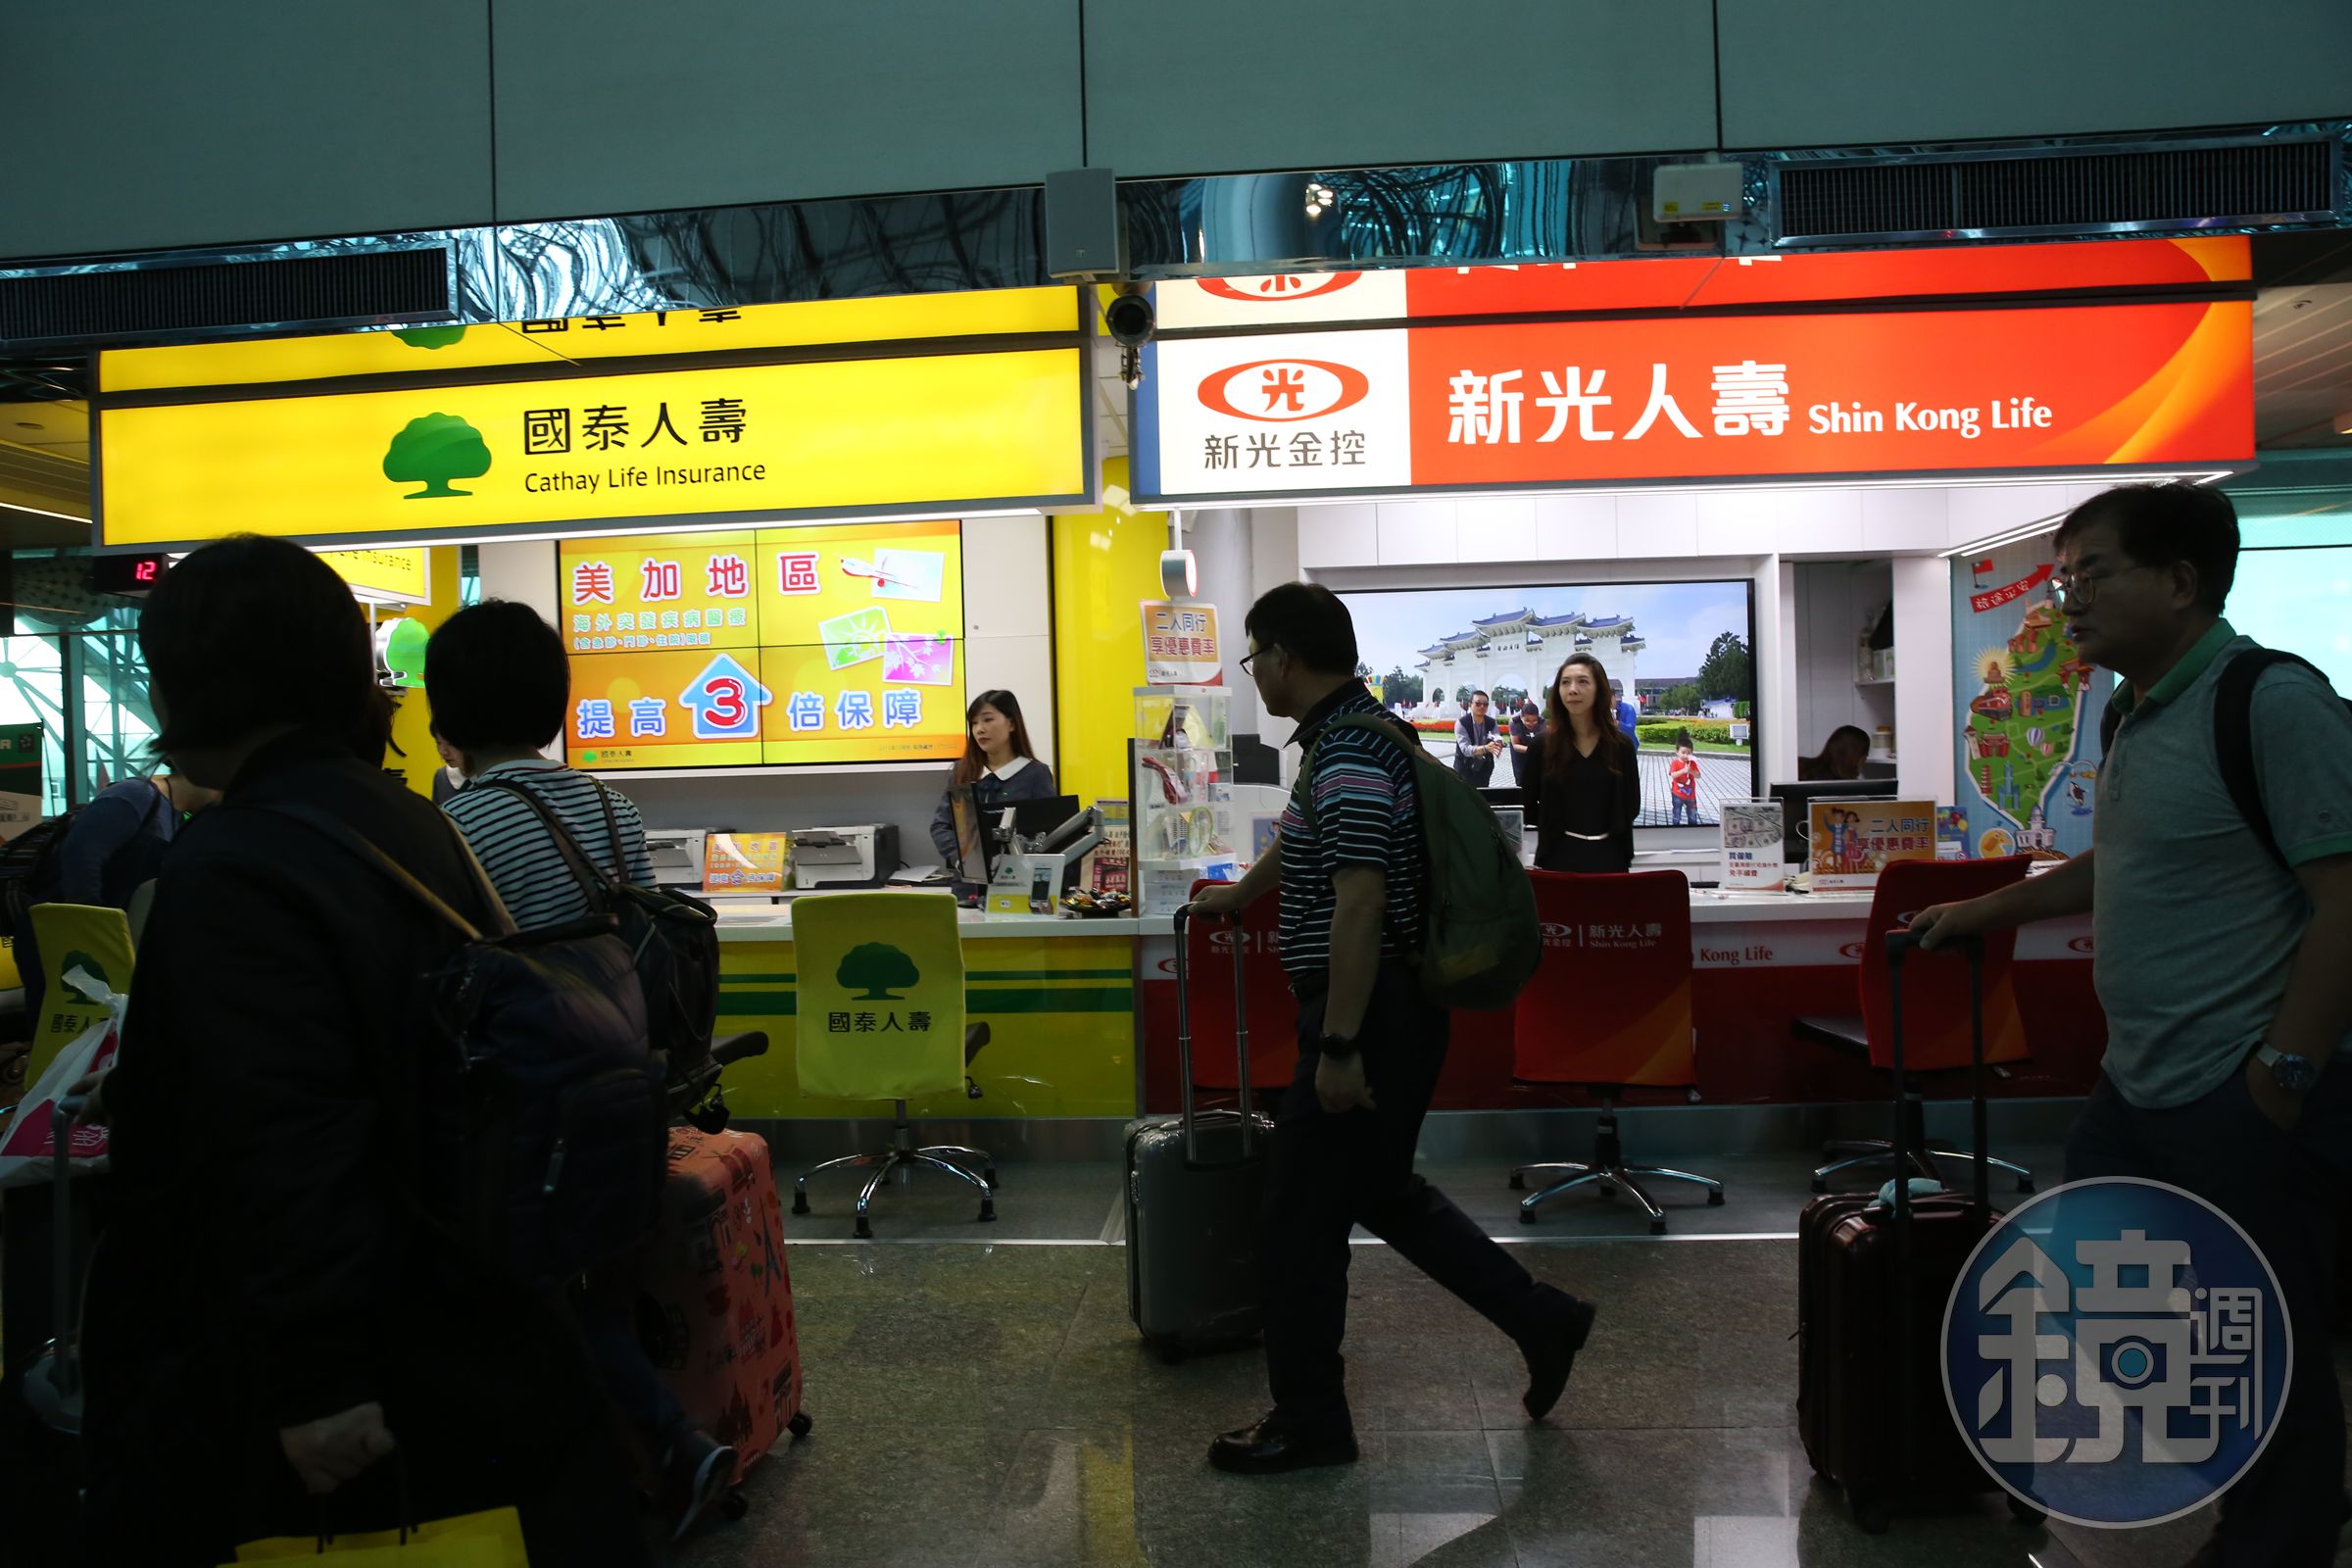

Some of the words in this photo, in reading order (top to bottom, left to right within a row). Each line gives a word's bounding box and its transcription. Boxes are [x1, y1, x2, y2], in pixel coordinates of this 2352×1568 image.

[1262, 368, 1304, 412] 光
[1447, 361, 1789, 445] 新光人壽
[523, 398, 747, 456] 國泰人壽
[1808, 401, 1884, 434] Shin
[1894, 401, 1982, 439] Kong
[1991, 396, 2053, 429] Life
[1204, 429, 1366, 469] 新光金控
[524, 470, 600, 494] Cathay
[609, 466, 648, 488] Life
[657, 464, 766, 486] Insurance
[135, 562, 157, 581] 12
[575, 555, 817, 603] 美加地區
[1156, 612, 1206, 632] 二人同行
[1150, 636, 1215, 656] 享優惠費率
[1871, 818, 1930, 833] 二人同行
[1589, 923, 1663, 939] 新光人壽
[1699, 948, 1740, 965] Kong
[1744, 946, 1773, 961] Life
[51, 1013, 109, 1034] 國泰人
[829, 1011, 932, 1033] 國泰人壽
